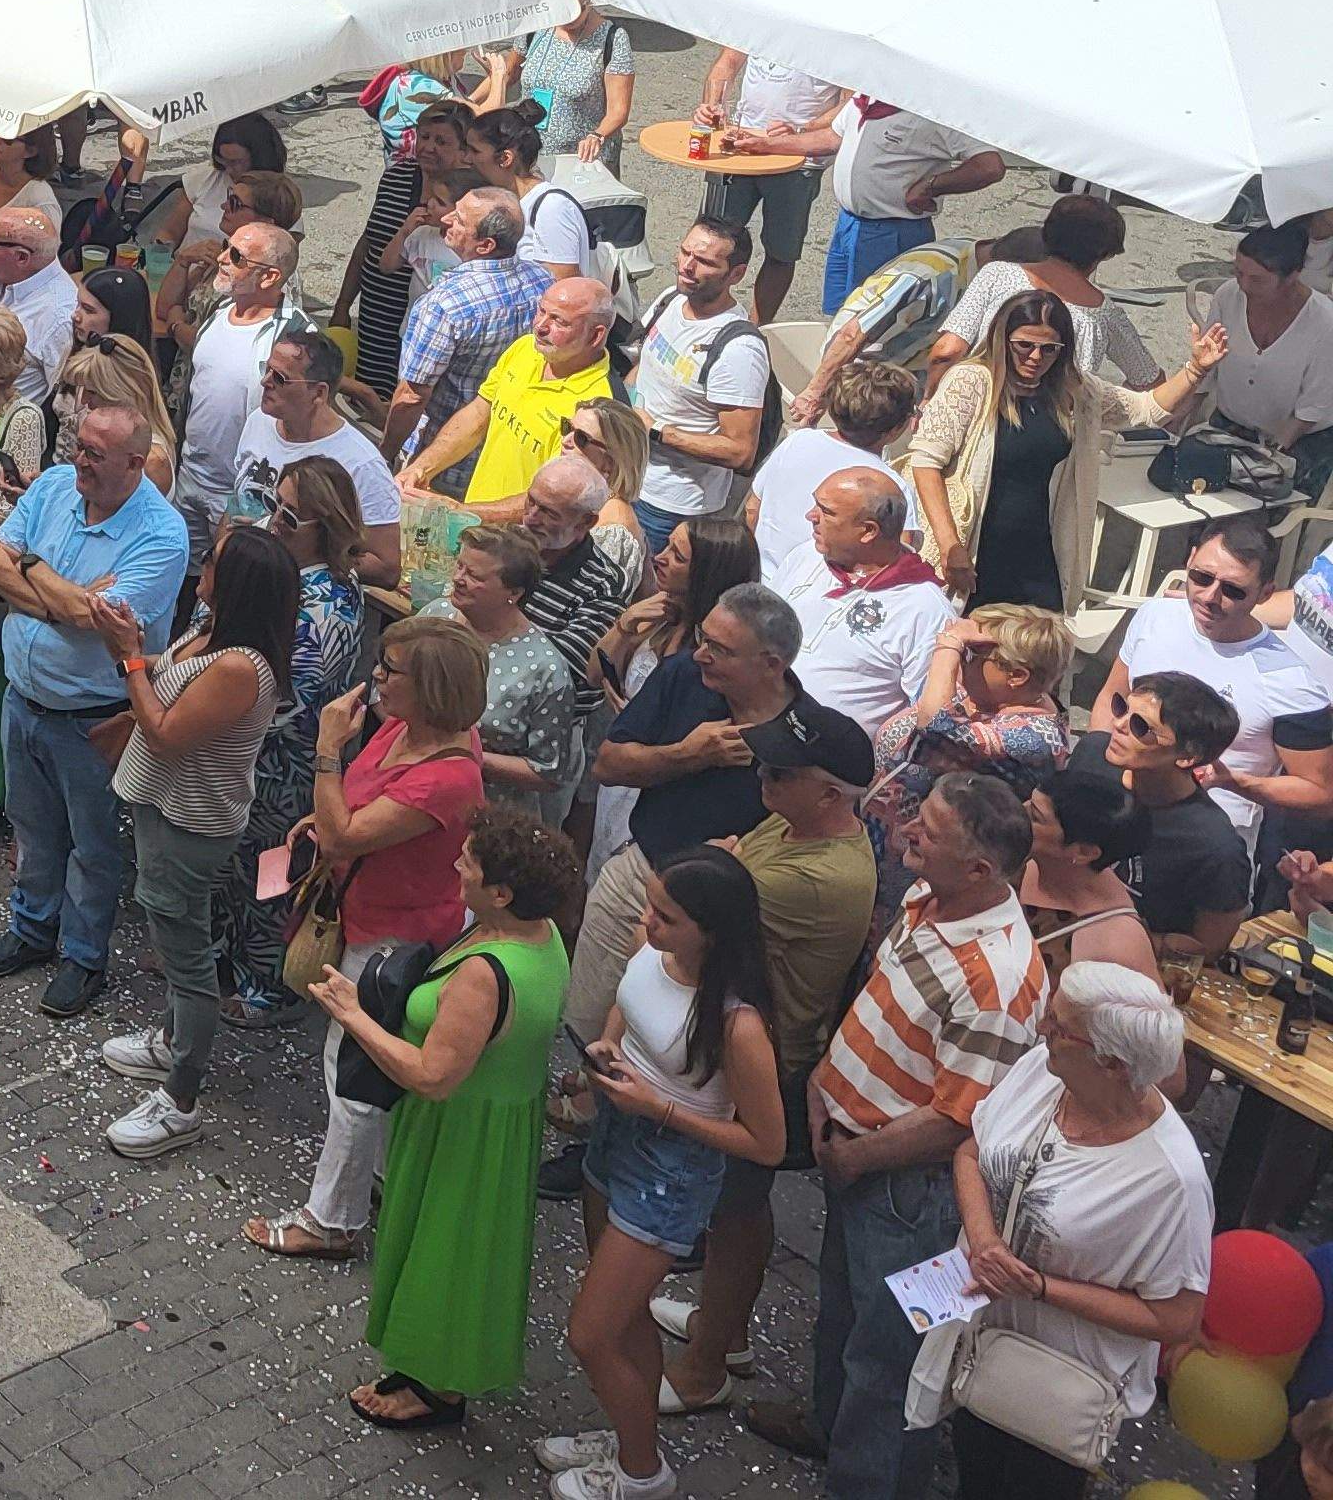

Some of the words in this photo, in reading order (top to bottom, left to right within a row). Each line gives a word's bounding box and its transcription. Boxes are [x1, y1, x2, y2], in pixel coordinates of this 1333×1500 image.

[406, 21, 465, 43] CERVECEROS
[466, 2, 550, 30] INDEPENDIENTES
[152, 90, 208, 126] MBAR
[491, 399, 542, 454] ACKETT
